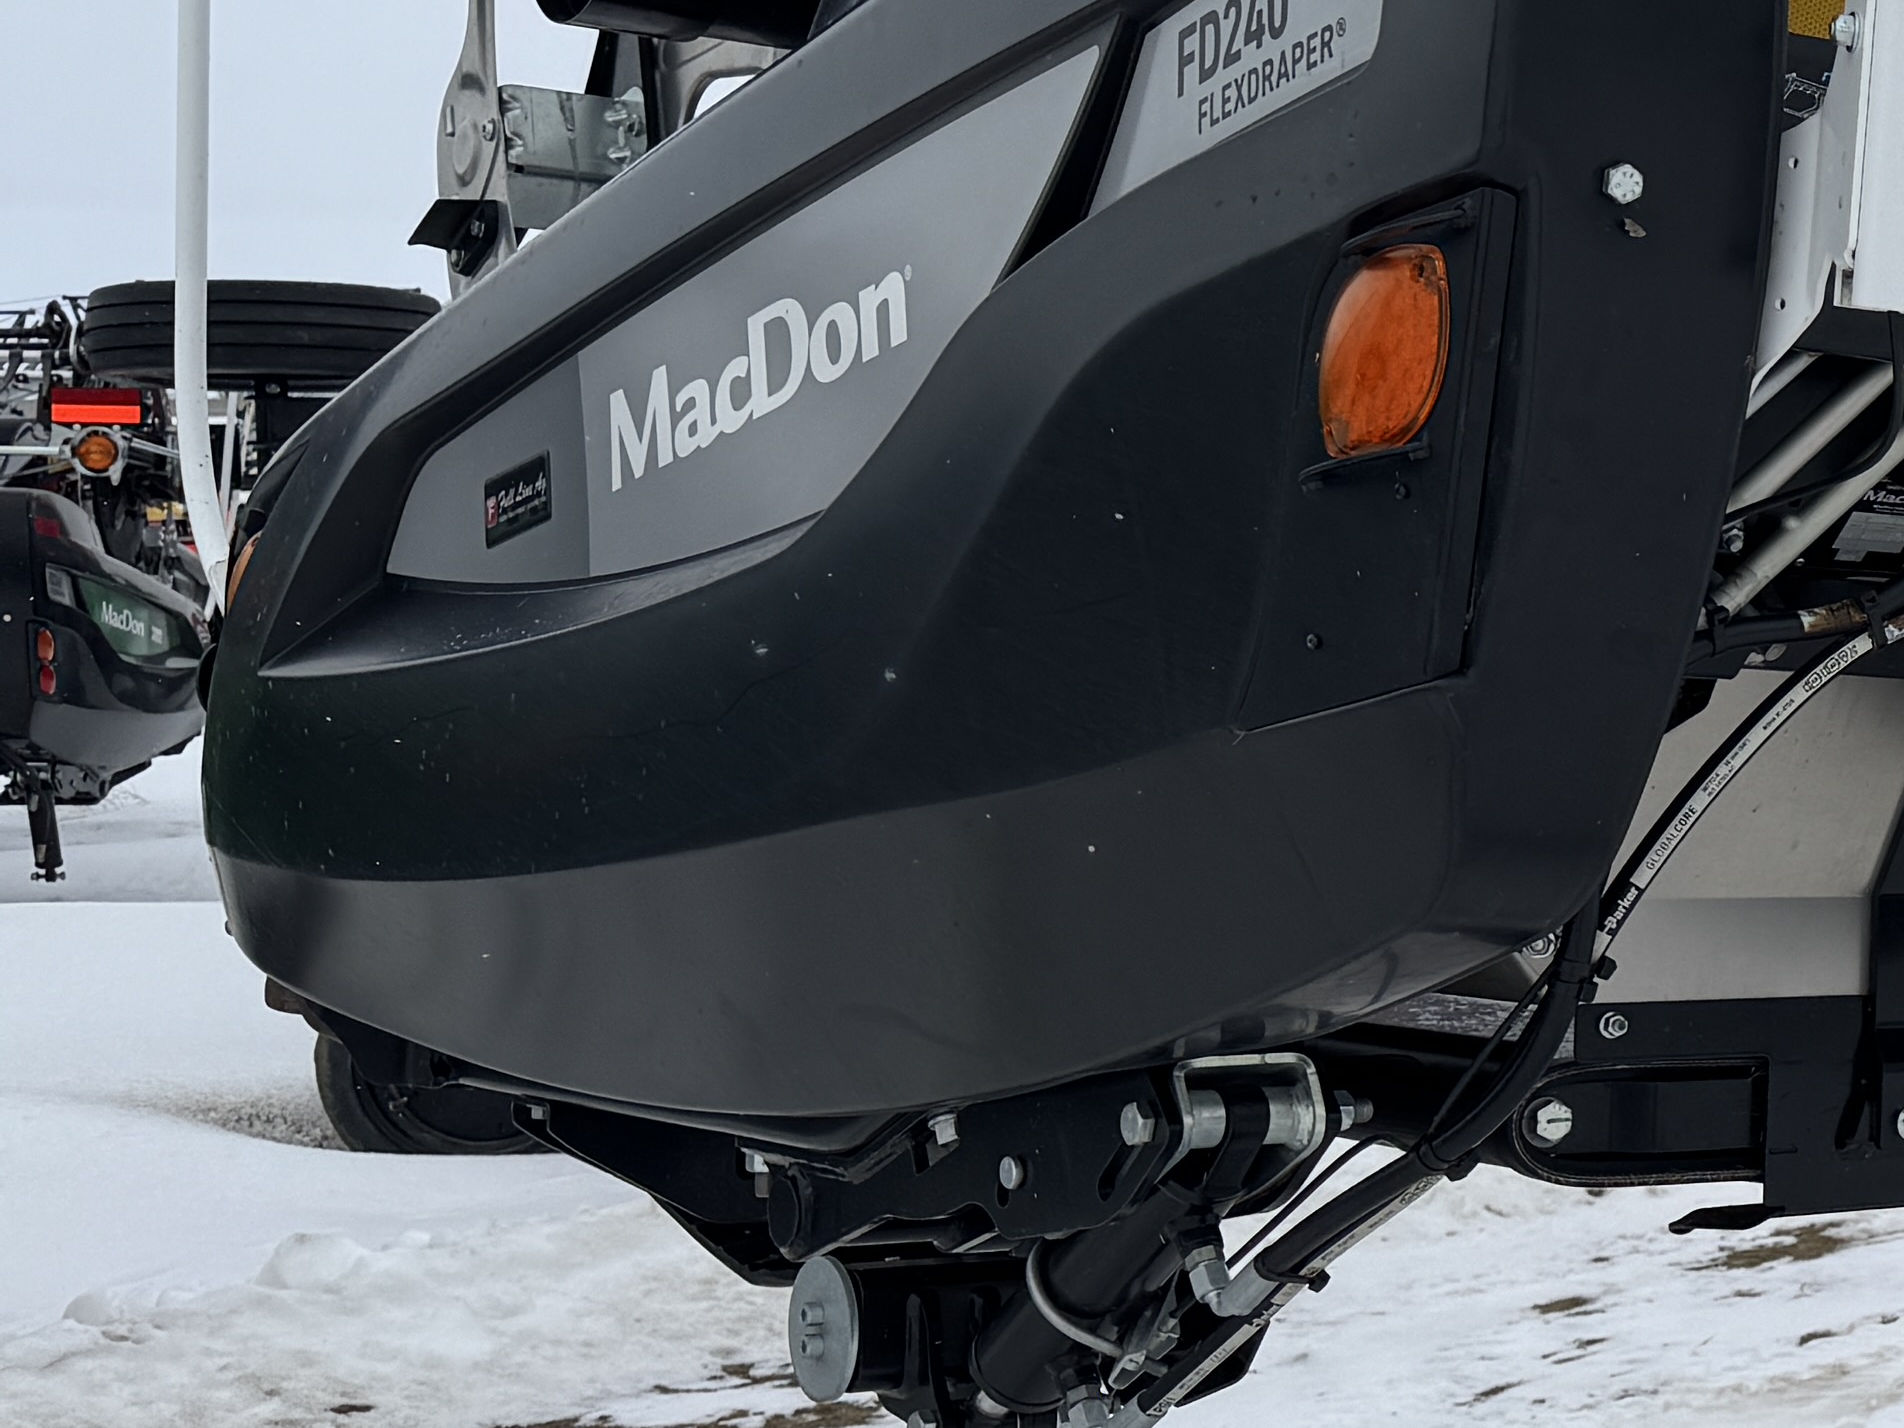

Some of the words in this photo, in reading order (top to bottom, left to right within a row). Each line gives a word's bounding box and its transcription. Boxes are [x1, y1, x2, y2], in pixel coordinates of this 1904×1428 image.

[101, 601, 145, 637] MacDon
[1646, 804, 1698, 871] GLOBALCORE
[1604, 885, 1640, 930] Parker
